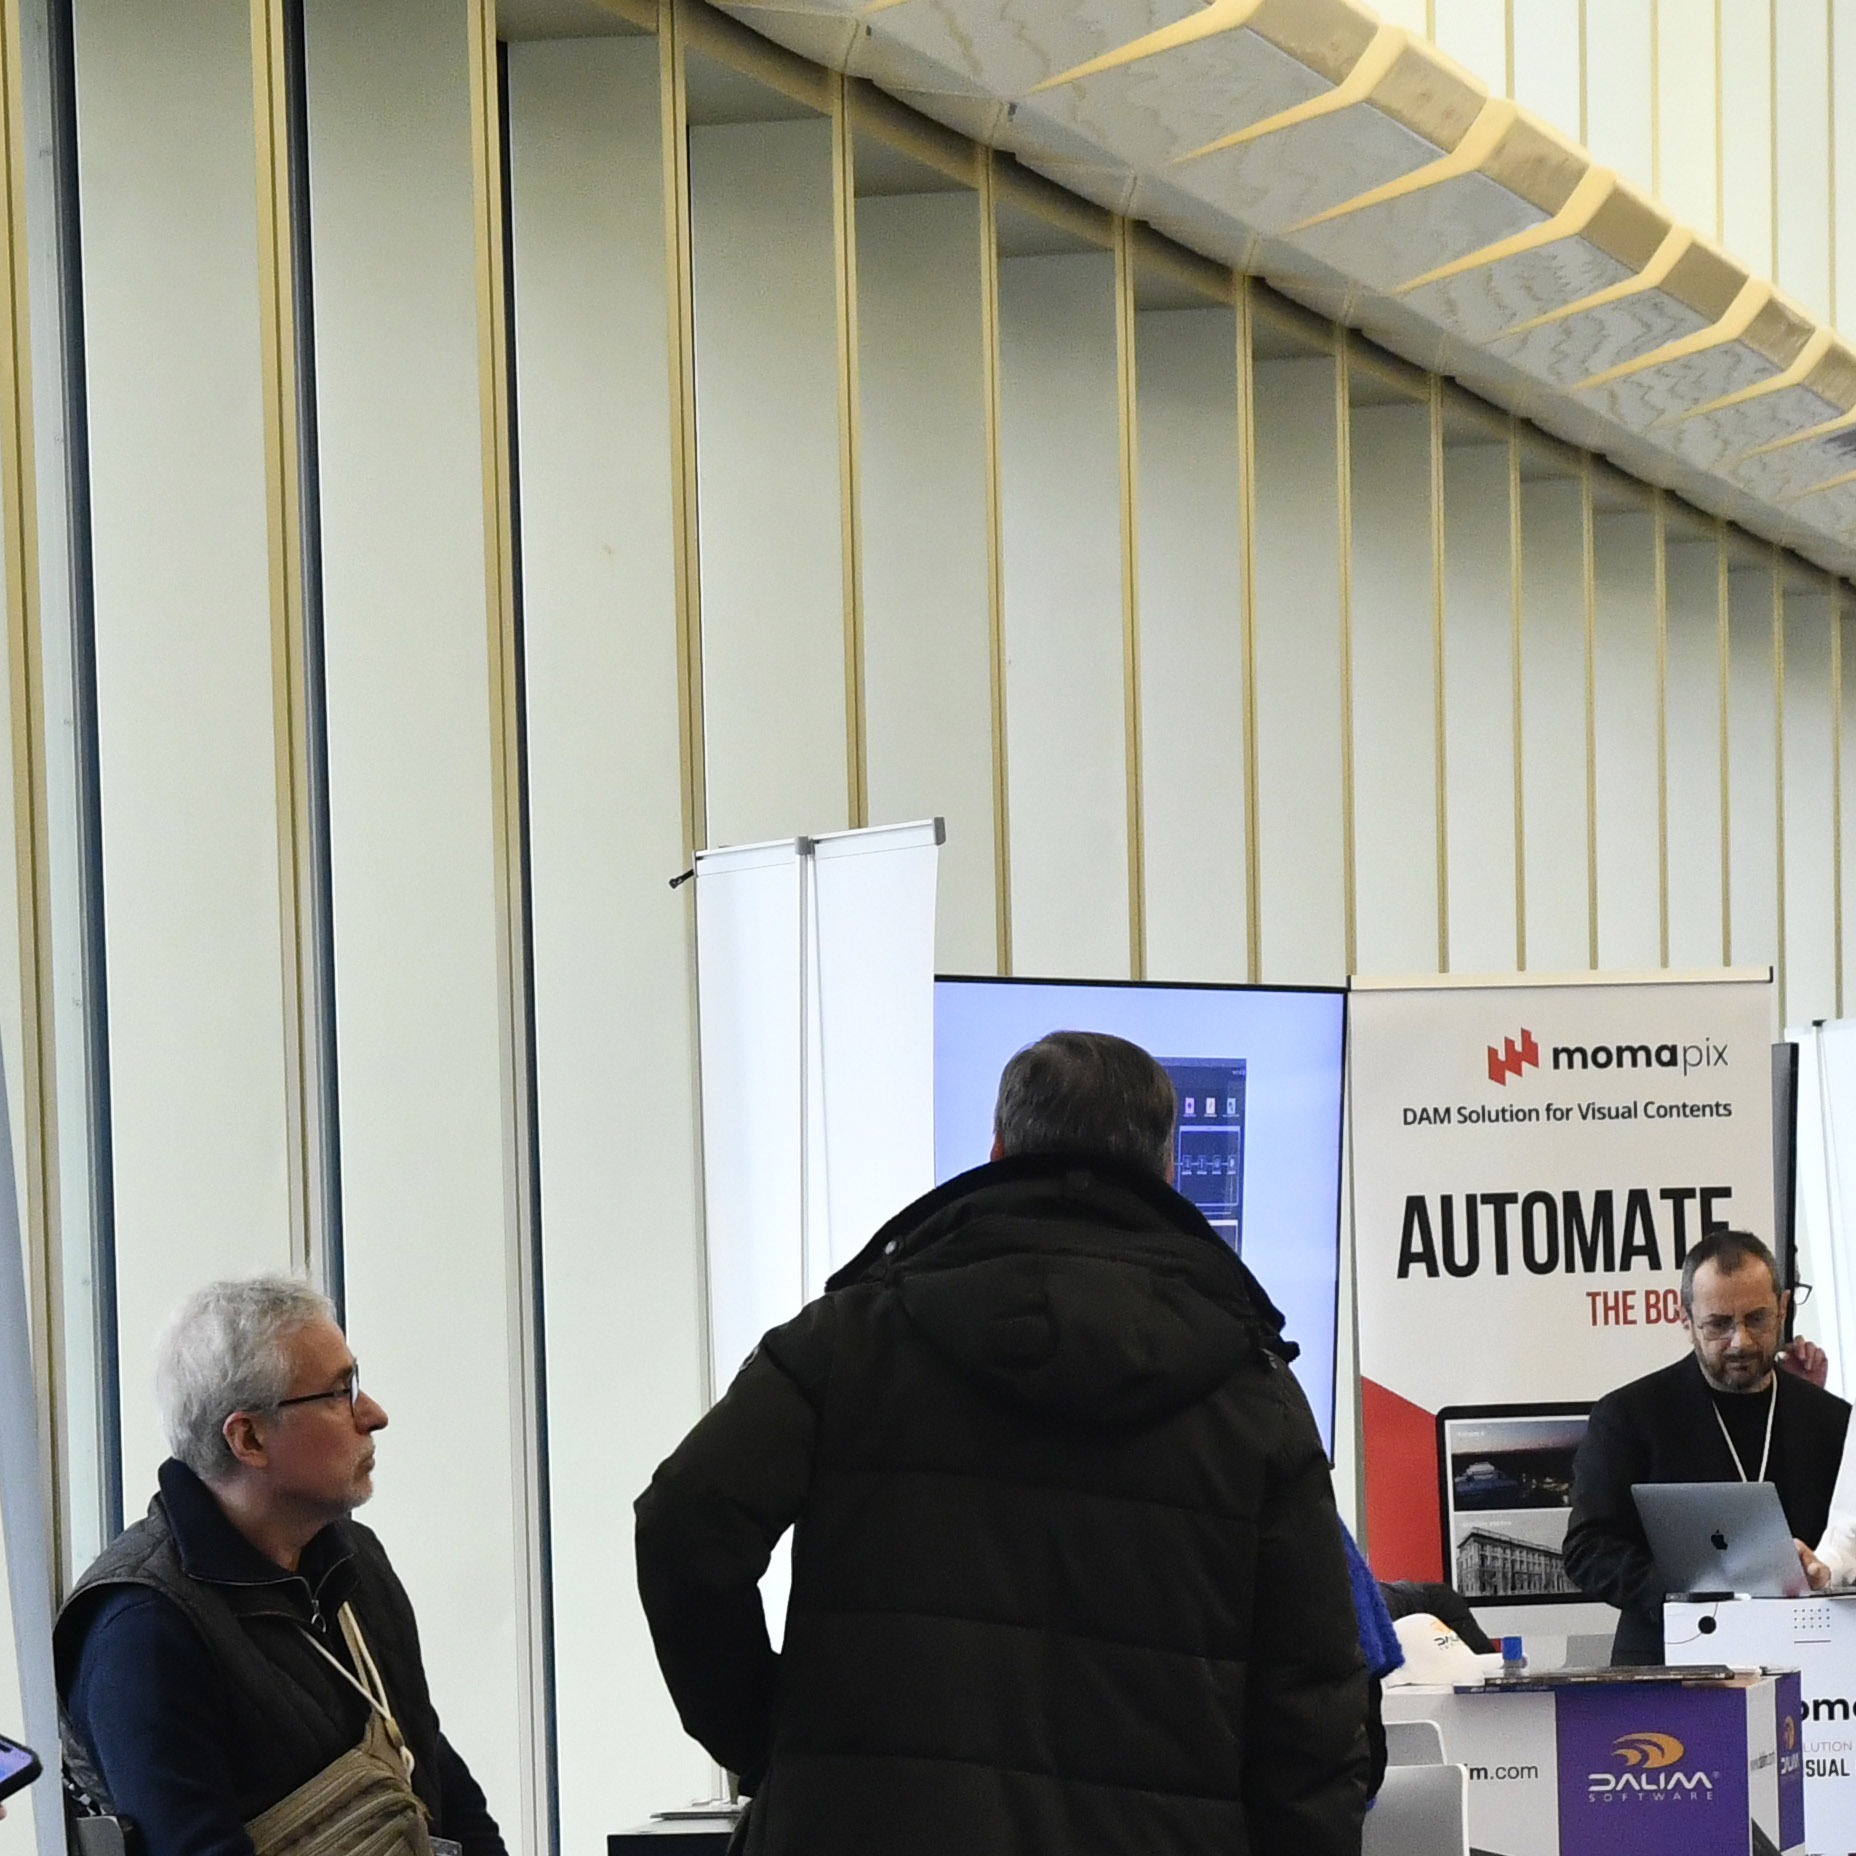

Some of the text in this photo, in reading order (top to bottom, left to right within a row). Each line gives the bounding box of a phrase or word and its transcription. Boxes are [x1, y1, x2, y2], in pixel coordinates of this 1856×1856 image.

[1552, 1037, 1730, 1076] momapix
[1402, 1100, 1733, 1126] DAM Solution for Visual Contents
[1585, 1288, 1680, 1326] THE BO
[1803, 1741, 1853, 1753] LUTION
[1805, 1758, 1851, 1777] SUAL
[1588, 1791, 1713, 1802] SOFTWARE
